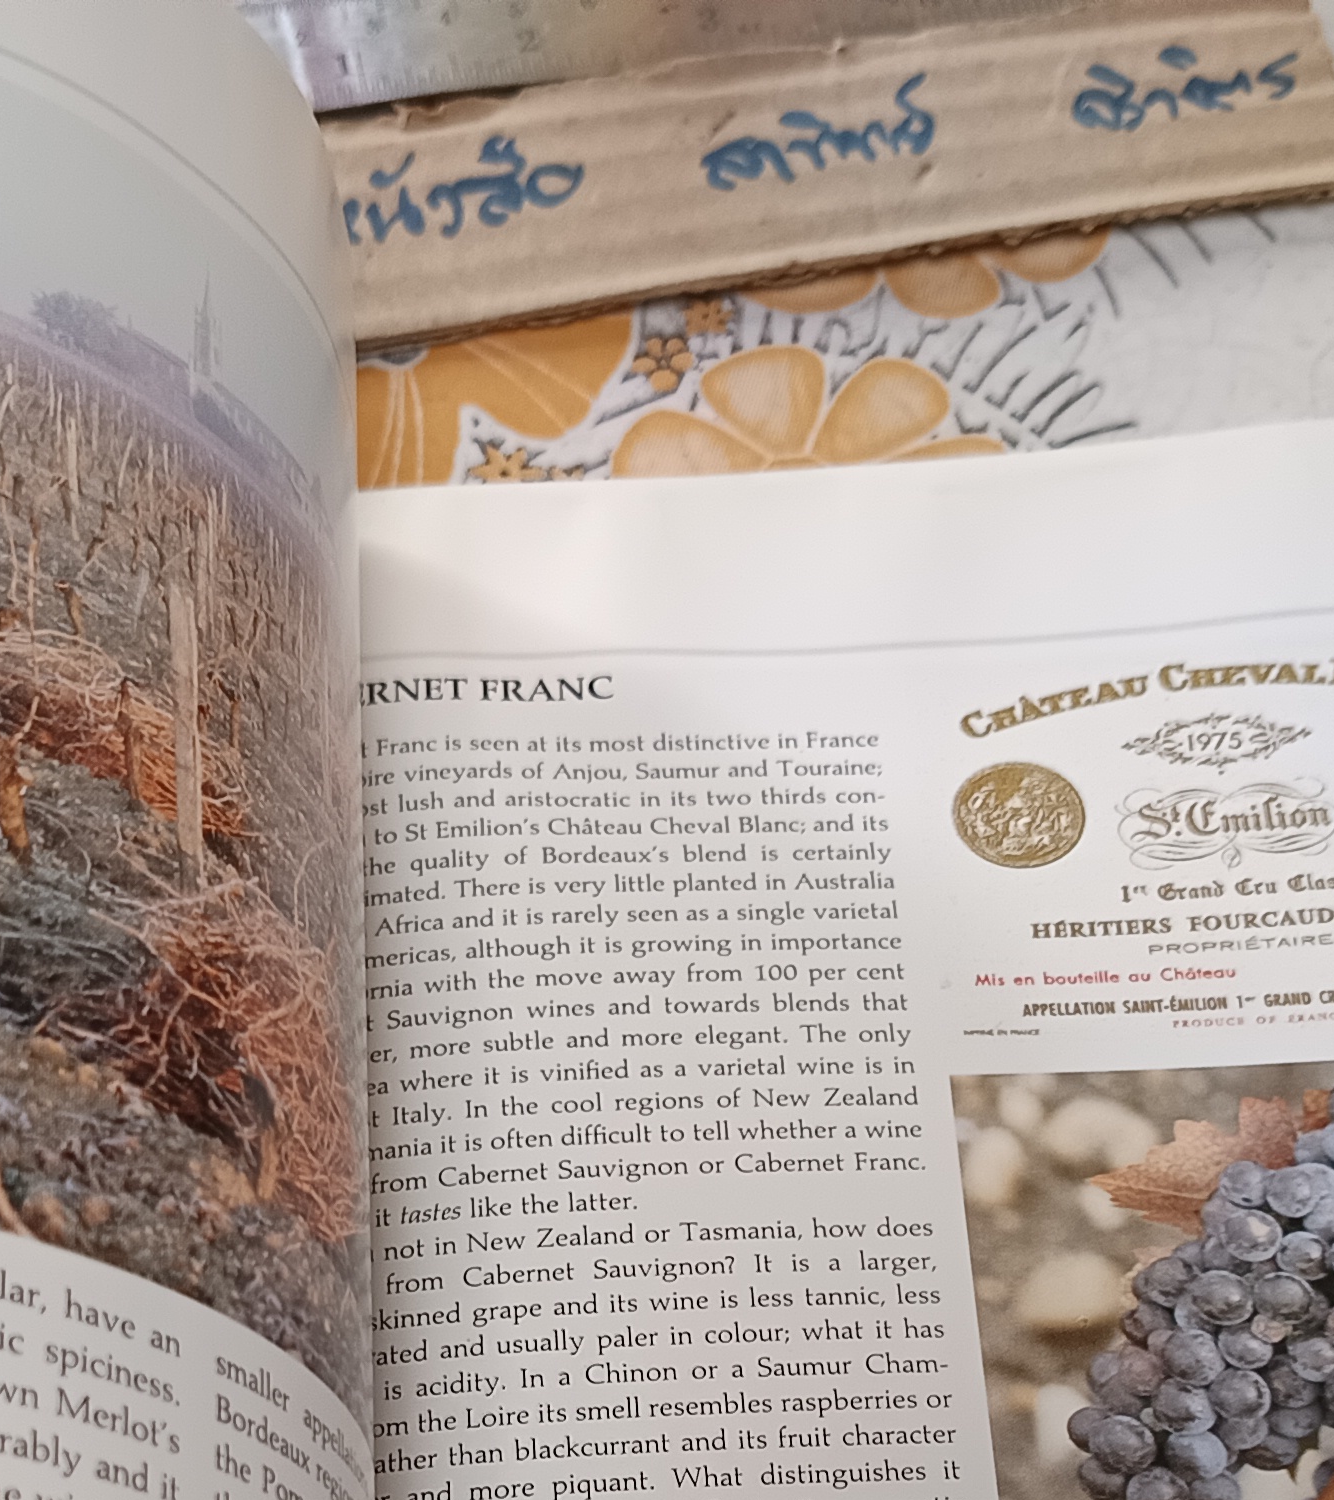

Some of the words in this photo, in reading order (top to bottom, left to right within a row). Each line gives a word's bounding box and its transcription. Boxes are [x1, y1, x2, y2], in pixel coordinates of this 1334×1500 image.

[479, 675, 614, 703] FRANC
[1184, 730, 1244, 753] 1975
[1156, 879, 1225, 902] Grand
[1233, 877, 1278, 897] Cru
[373, 913, 445, 938] Africa
[451, 906, 495, 930] and
[501, 908, 519, 927] it
[526, 907, 544, 926] is
[551, 902, 620, 929] rarely
[626, 908, 679, 923] seen
[685, 908, 710, 922] as
[716, 908, 729, 921] a
[736, 900, 806, 927] single
[812, 899, 899, 920] varietal
[1030, 916, 1173, 940] HÉRITIERS
[974, 973, 1006, 987] Mis
[1012, 975, 1036, 987] en
[1042, 969, 1121, 986] bouteille
[1127, 972, 1152, 983] au
[1159, 966, 1237, 983] Château
[1022, 1000, 1117, 1018] APPELLATION
[1121, 994, 1229, 1015] SAINT-ÉMILION
[1263, 991, 1313, 1008] GRAND
[1171, 1016, 1245, 1029] PRODUCE
[369, 1172, 428, 1197] from
[437, 1161, 549, 1188] Cabernet
[557, 1158, 689, 1183] Sauvignon
[698, 1159, 725, 1175] or
[734, 1151, 845, 1174] Cabernet
[854, 1151, 926, 1172] Franc.
[64, 1287, 136, 1340] have
[149, 1329, 181, 1358] an
[45, 1344, 181, 1407] spiciness.
